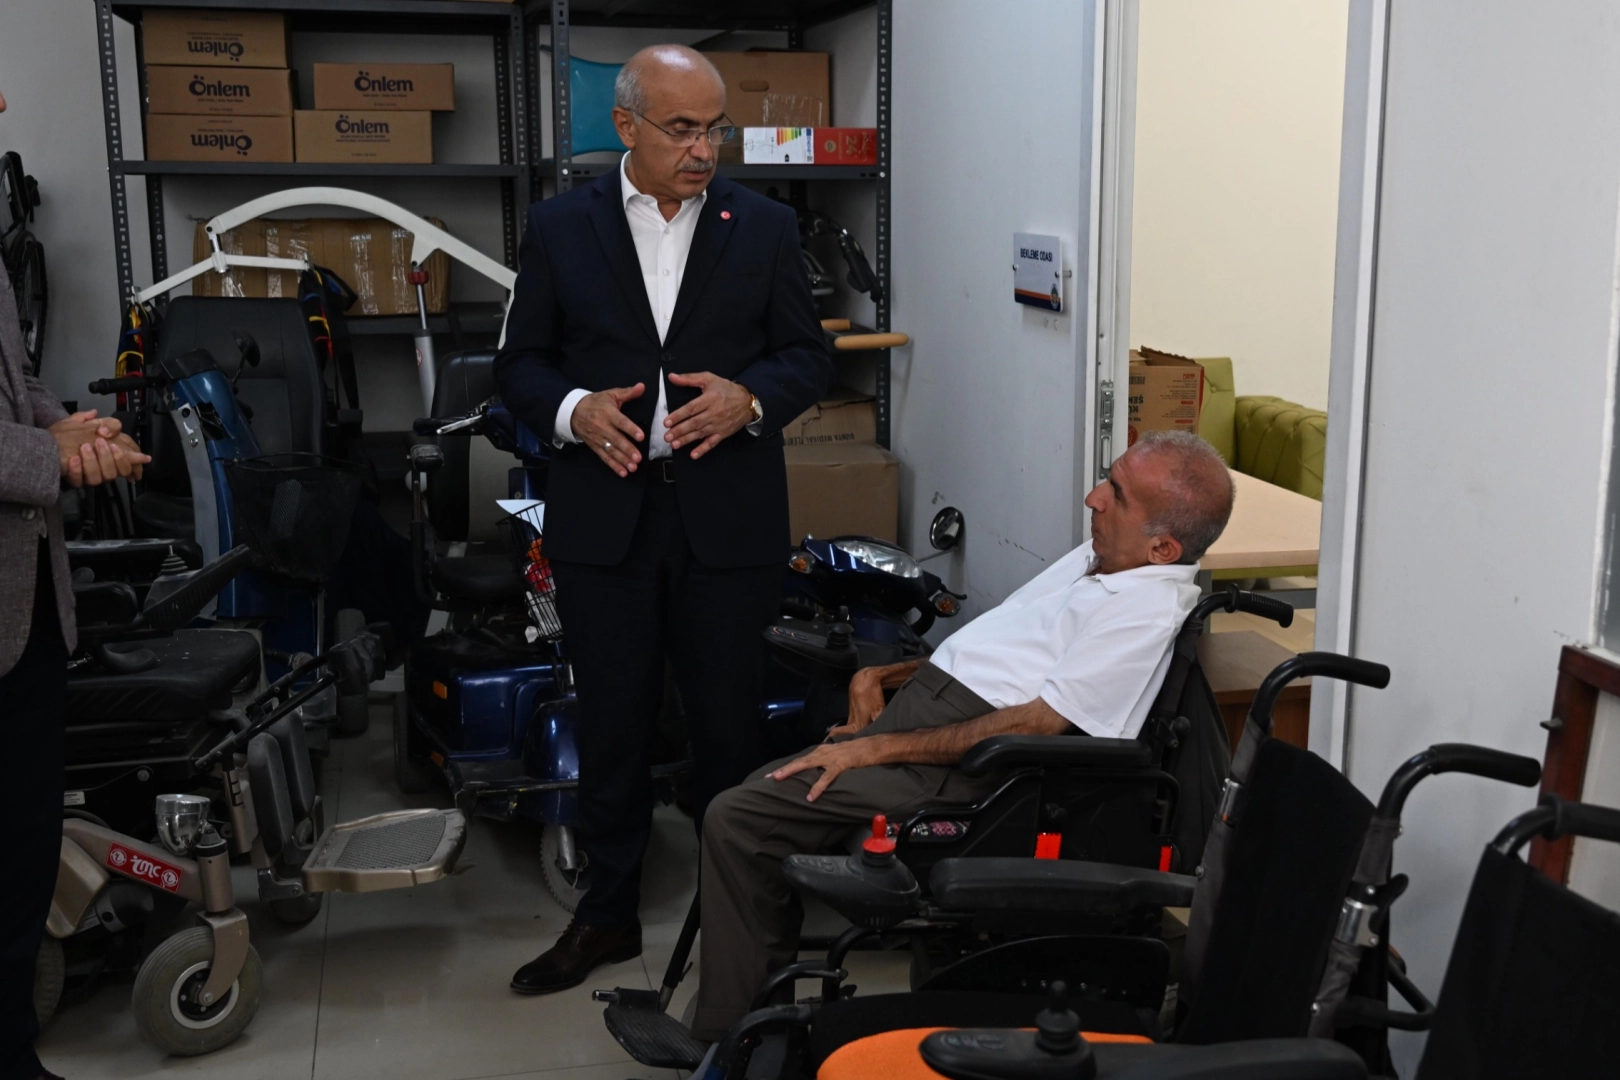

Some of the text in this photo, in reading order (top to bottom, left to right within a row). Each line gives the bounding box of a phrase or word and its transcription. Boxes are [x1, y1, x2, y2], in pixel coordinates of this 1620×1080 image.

[187, 41, 244, 62] Önlem
[189, 75, 251, 97] Önlem
[354, 70, 414, 92] Önlem
[335, 114, 390, 134] Önlem
[190, 134, 252, 156] Önlem
[1020, 248, 1053, 262] BEKLEME ODASI
